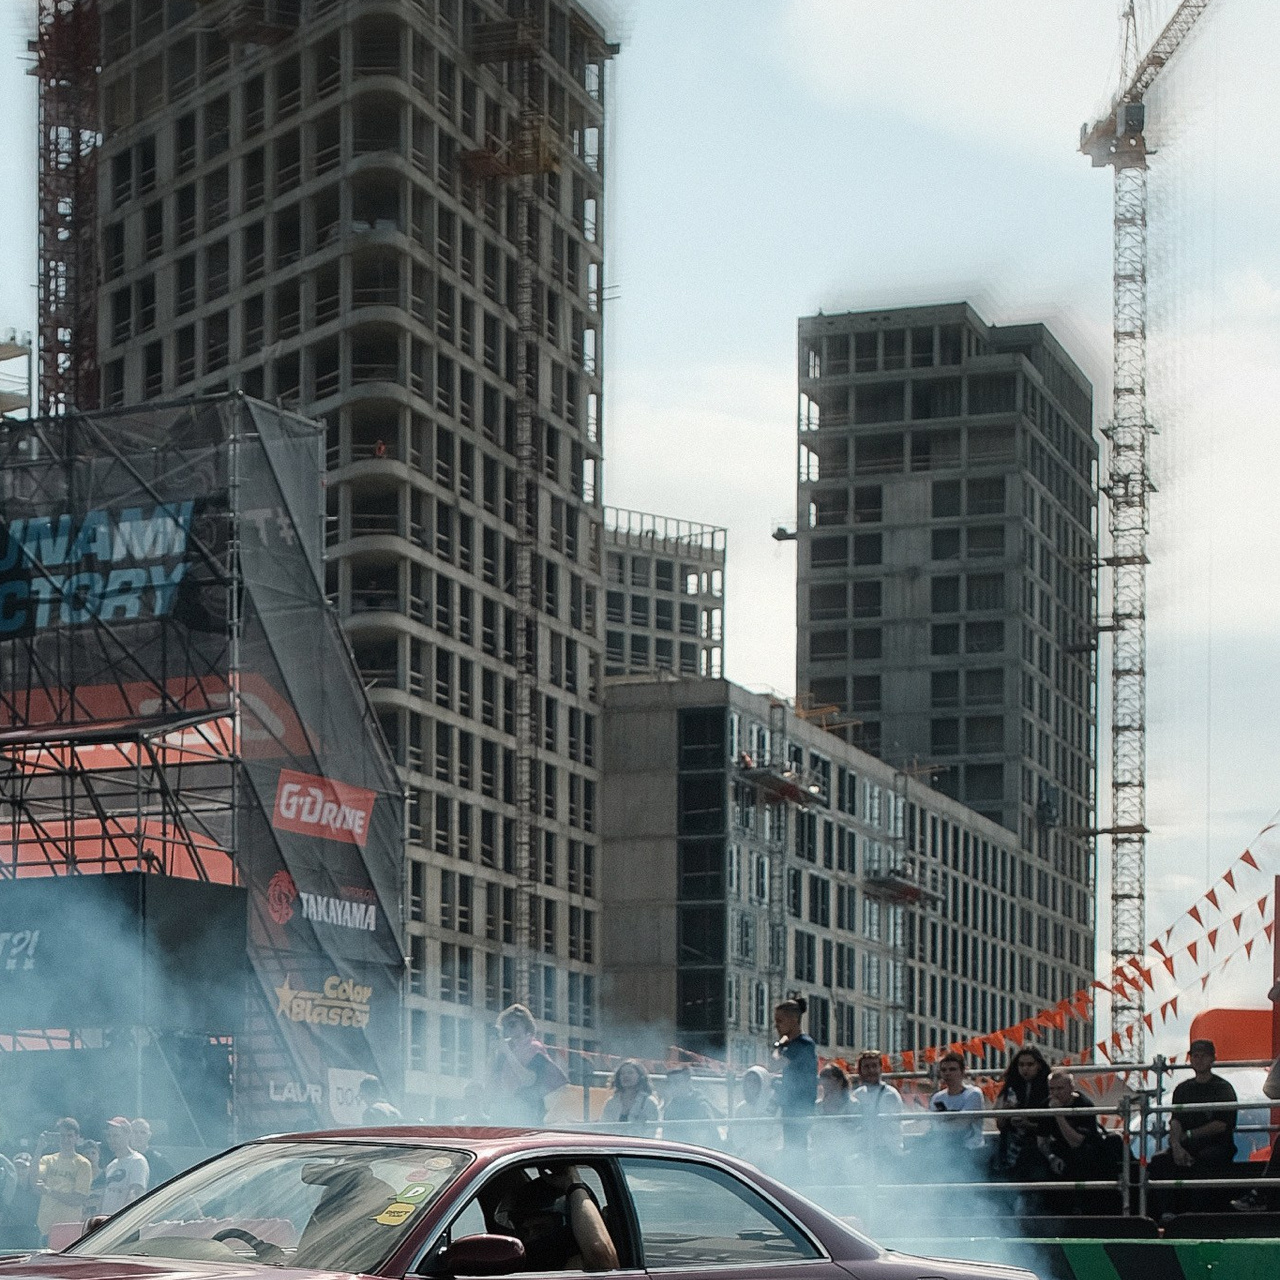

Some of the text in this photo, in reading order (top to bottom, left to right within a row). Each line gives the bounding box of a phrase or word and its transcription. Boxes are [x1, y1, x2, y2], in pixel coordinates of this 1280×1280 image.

[299, 891, 377, 931] TAKAYAMA
[323, 975, 373, 1003] Color
[290, 999, 370, 1028] Blaster
[269, 1080, 322, 1104] LAVR
